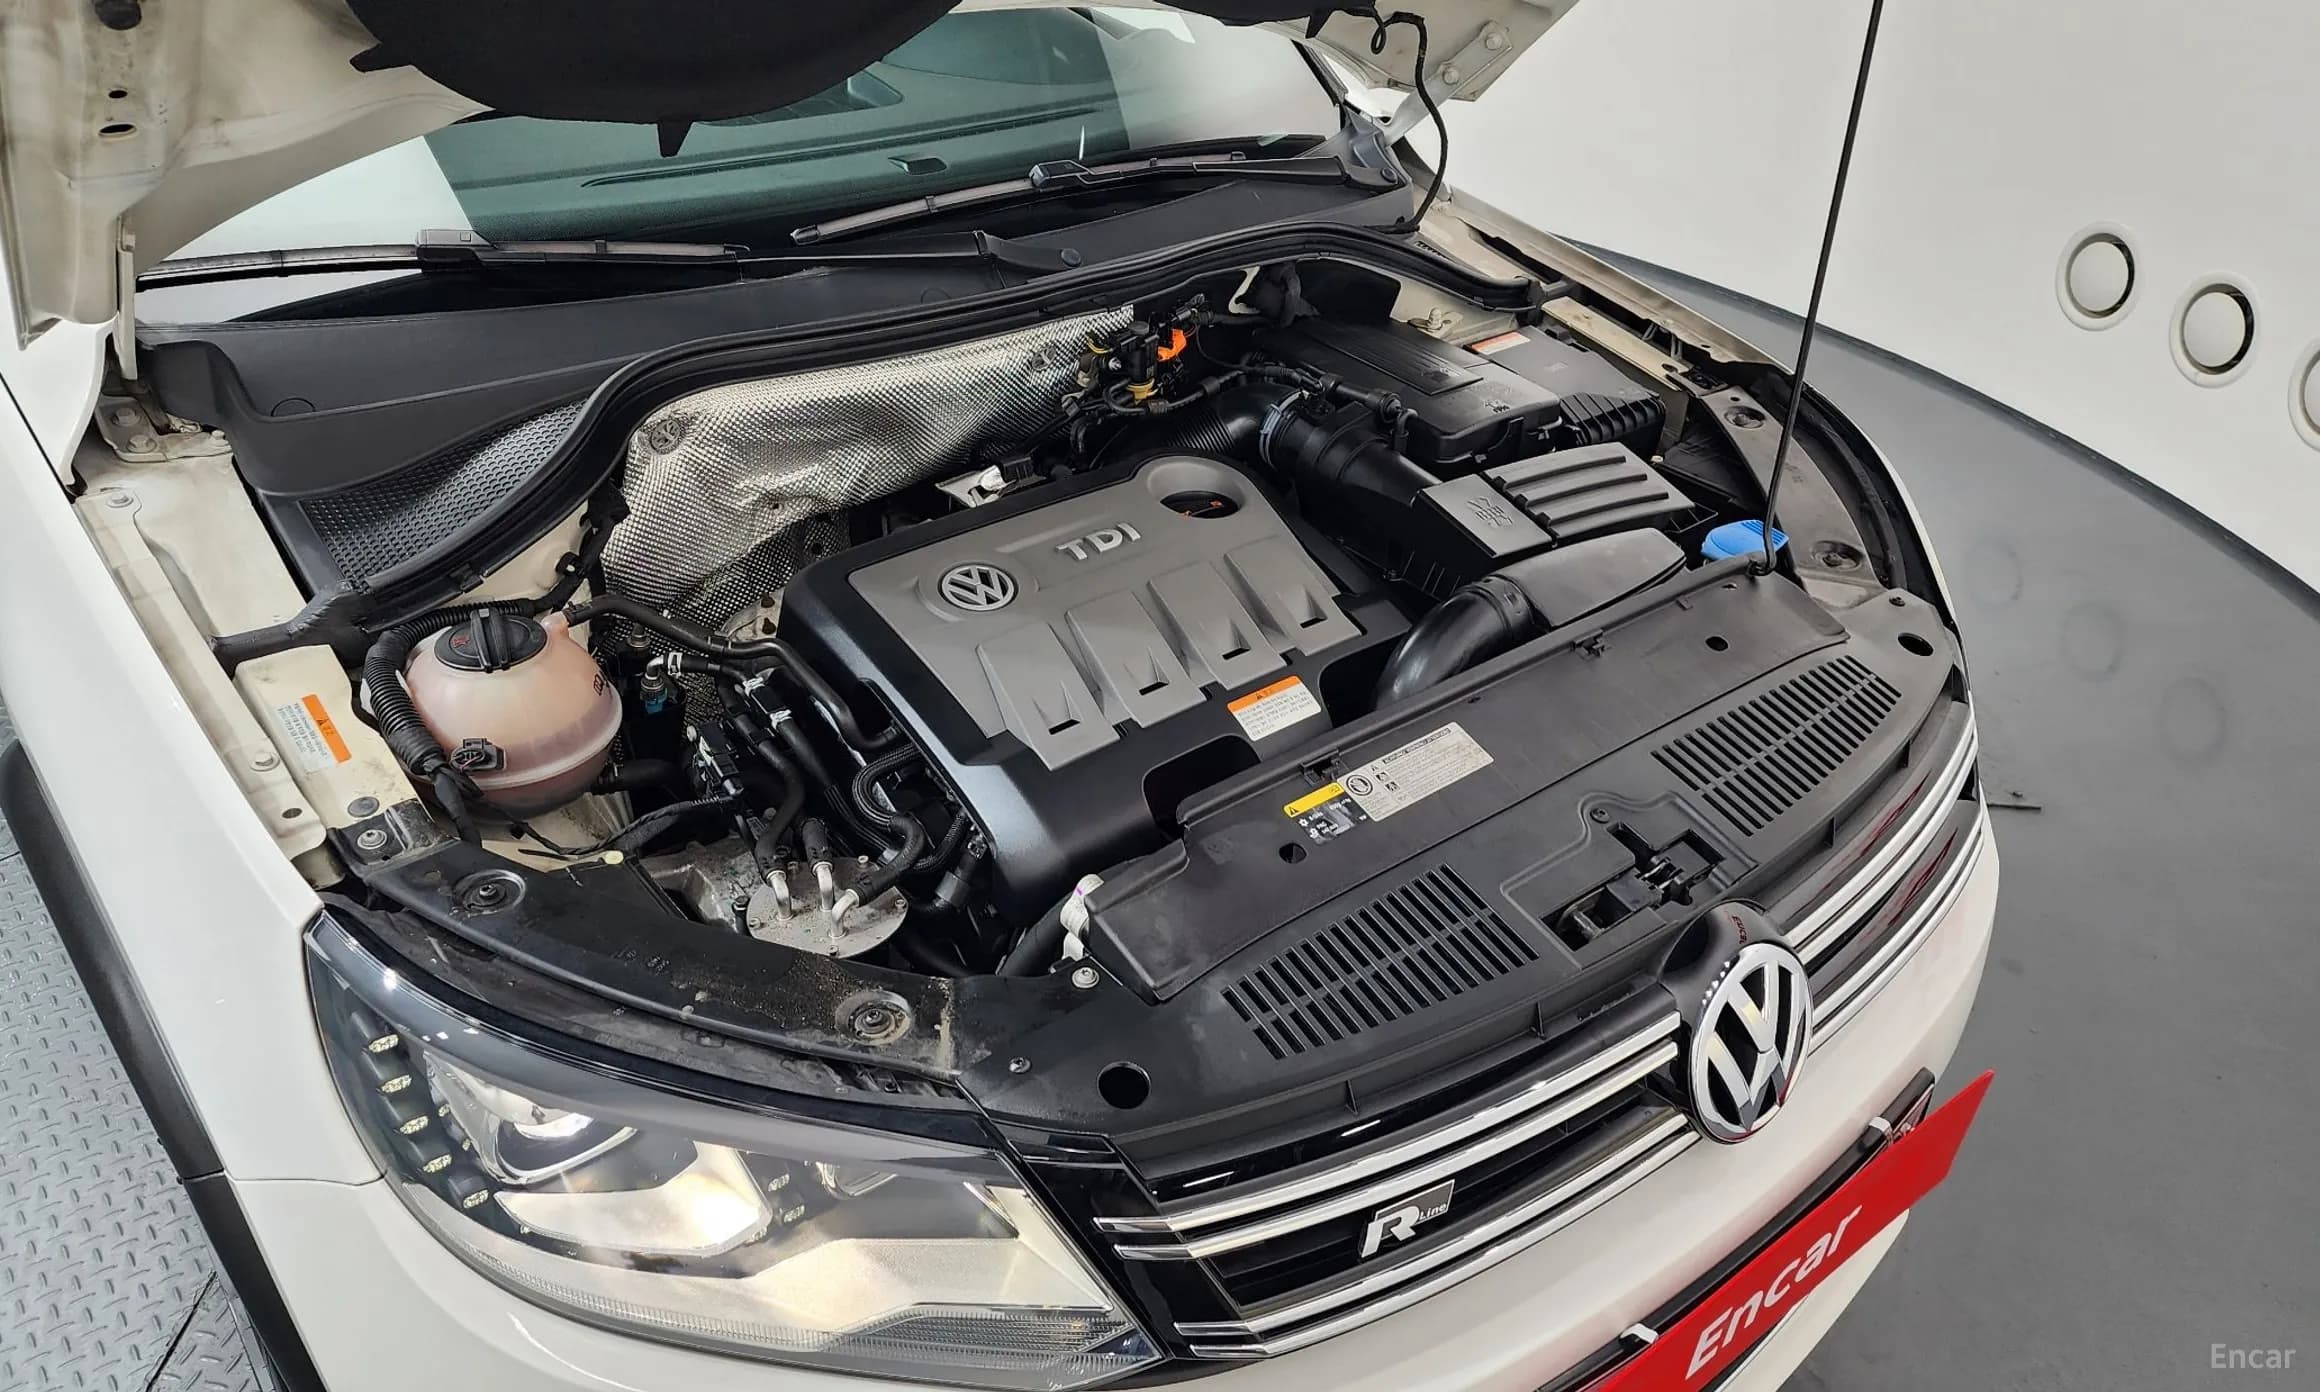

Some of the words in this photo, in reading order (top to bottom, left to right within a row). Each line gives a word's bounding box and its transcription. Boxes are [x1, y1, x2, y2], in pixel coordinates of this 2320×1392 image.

[1055, 522, 1141, 561] TDI
[941, 565, 1015, 611] VW
[1690, 942, 1812, 1145] VW
[1361, 1205, 1417, 1258] R
[1419, 1202, 1448, 1221] Line
[1685, 1204, 1863, 1381] Encar
